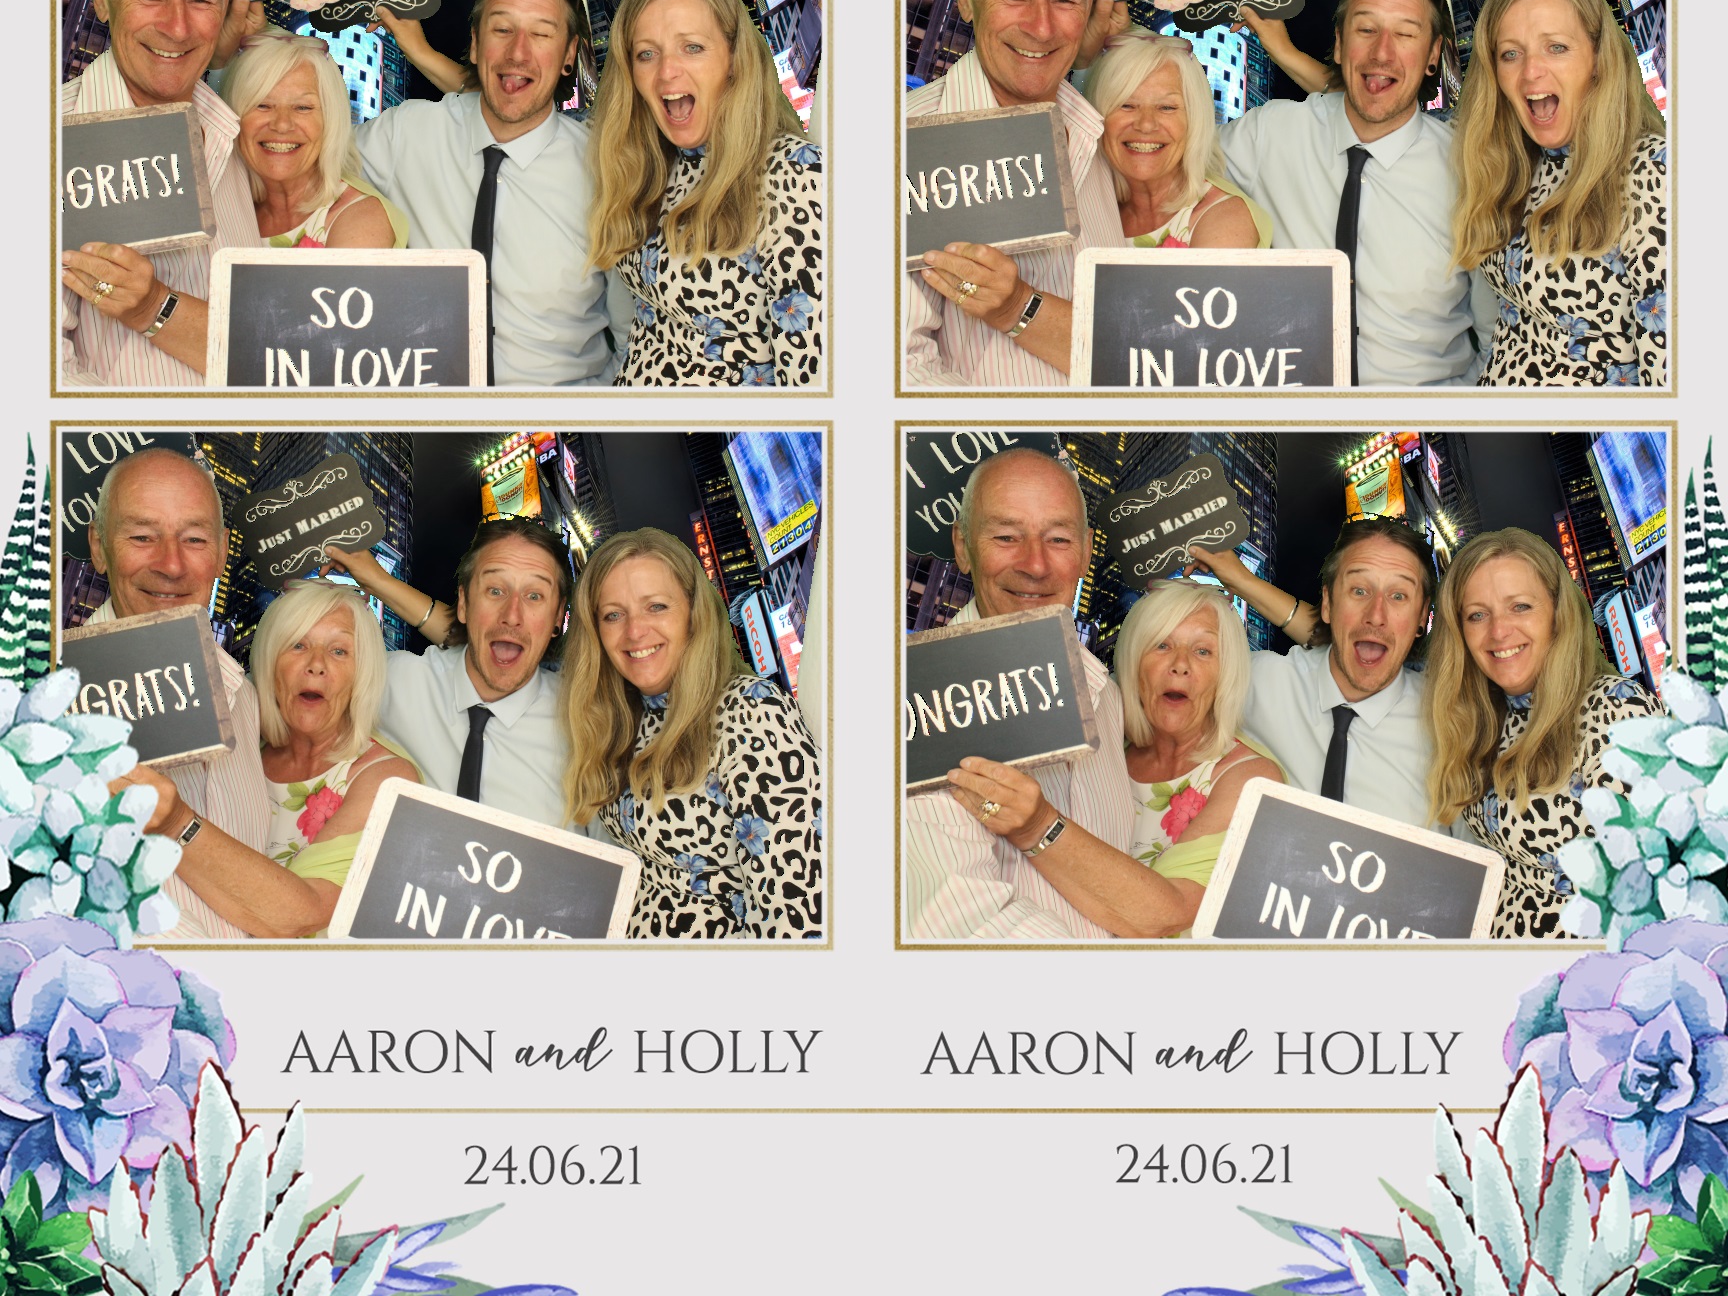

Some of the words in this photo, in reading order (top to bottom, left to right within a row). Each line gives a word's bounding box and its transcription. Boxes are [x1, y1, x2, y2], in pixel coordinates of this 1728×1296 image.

[62, 154, 184, 212] GRATS!
[906, 154, 1048, 215] NGRATS!
[310, 286, 374, 329] SO
[1174, 286, 1238, 329] SO
[266, 347, 310, 386] IN
[335, 347, 439, 386] LOVE
[1130, 347, 1174, 386] IN
[1199, 347, 1303, 386] LOVE
[257, 528, 293, 554] JUST
[294, 496, 364, 536] MARRIED
[767, 527, 781, 537] NYC
[781, 501, 814, 527] VEHICLES
[769, 524, 792, 543] COUNT
[772, 515, 817, 553] 21304
[1121, 528, 1157, 554] JUST
[1158, 496, 1228, 536] MARRIED
[1631, 527, 1645, 537] NYC
[1633, 524, 1656, 543] COUNT
[693, 521, 714, 581] ERNST
[1557, 521, 1578, 581] ERNST
[744, 605, 767, 673] RICOH
[1608, 605, 1631, 673] RICOH
[457, 841, 523, 893] SO
[1321, 841, 1387, 893] SO
[394, 881, 447, 937] IN
[1258, 881, 1311, 937] IN
